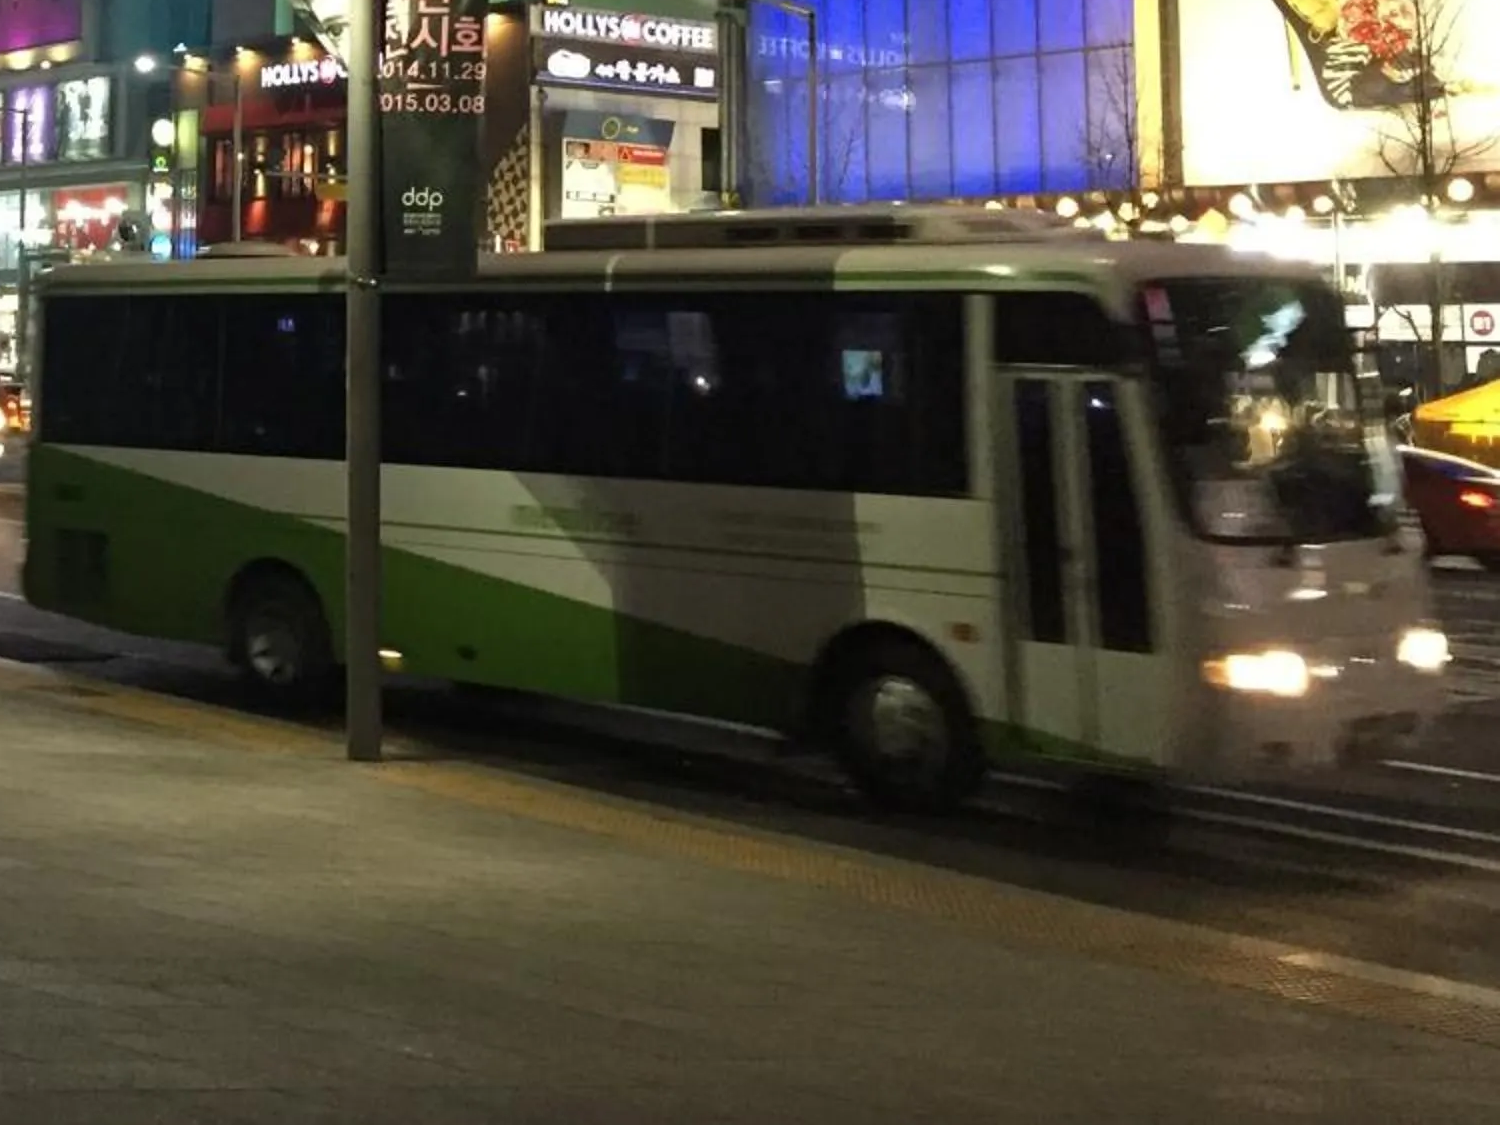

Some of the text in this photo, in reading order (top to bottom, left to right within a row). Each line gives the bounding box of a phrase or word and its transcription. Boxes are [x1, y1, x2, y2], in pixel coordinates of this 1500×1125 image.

[544, 11, 713, 49] HOLLYS COFFEE
[261, 61, 319, 87] HOLLYS
[378, 60, 487, 80] 014.11.29
[379, 94, 486, 114] 015.03.08
[401, 186, 444, 211] ddp
